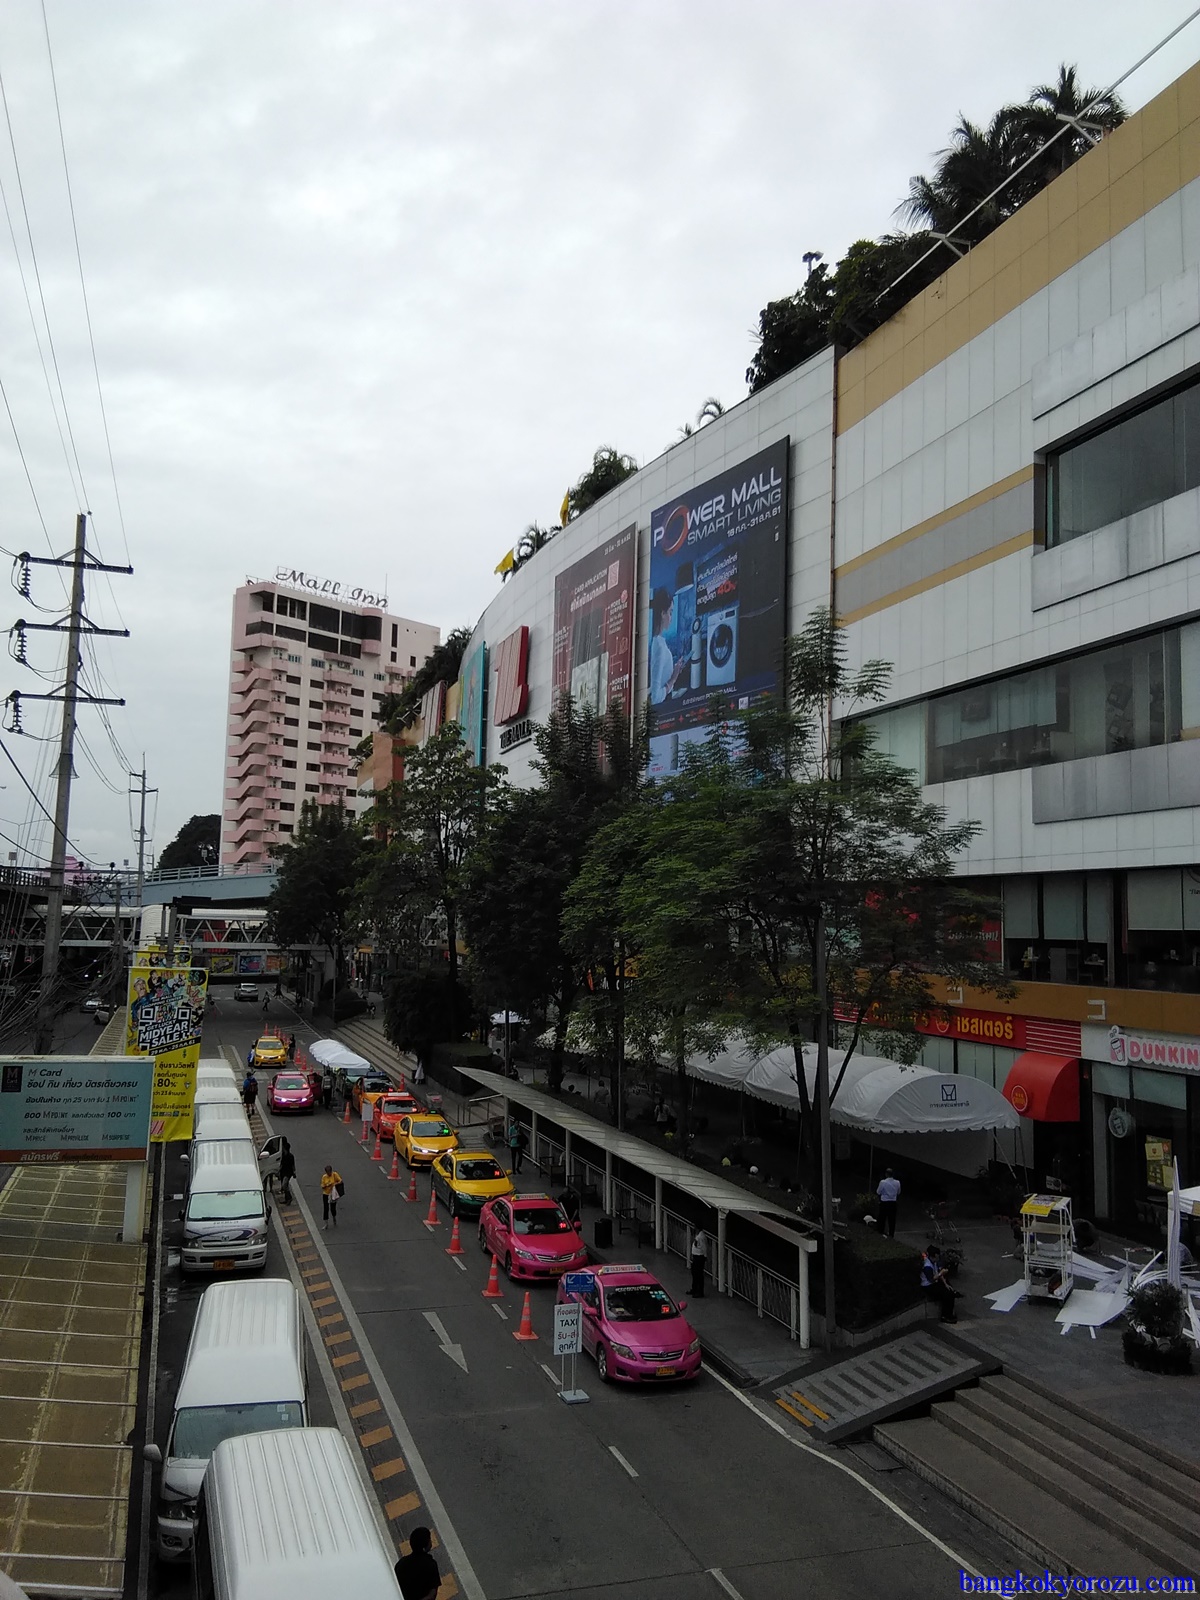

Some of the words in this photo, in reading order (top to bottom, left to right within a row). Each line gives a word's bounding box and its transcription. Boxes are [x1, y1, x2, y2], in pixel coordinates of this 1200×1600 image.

[731, 467, 782, 508] MALL
[687, 511, 733, 545] SMART
[737, 488, 782, 521] LIVING
[276, 570, 341, 595] Mall
[349, 588, 388, 608] Inn
[140, 1021, 189, 1043] MIDYEAR
[956, 1014, 1014, 1040] เชสเตอร์
[1129, 1041, 1199, 1067] DUNKIN
[28, 1069, 38, 1077] M
[39, 1068, 63, 1077] Card
[559, 1318, 578, 1327] TAXI
